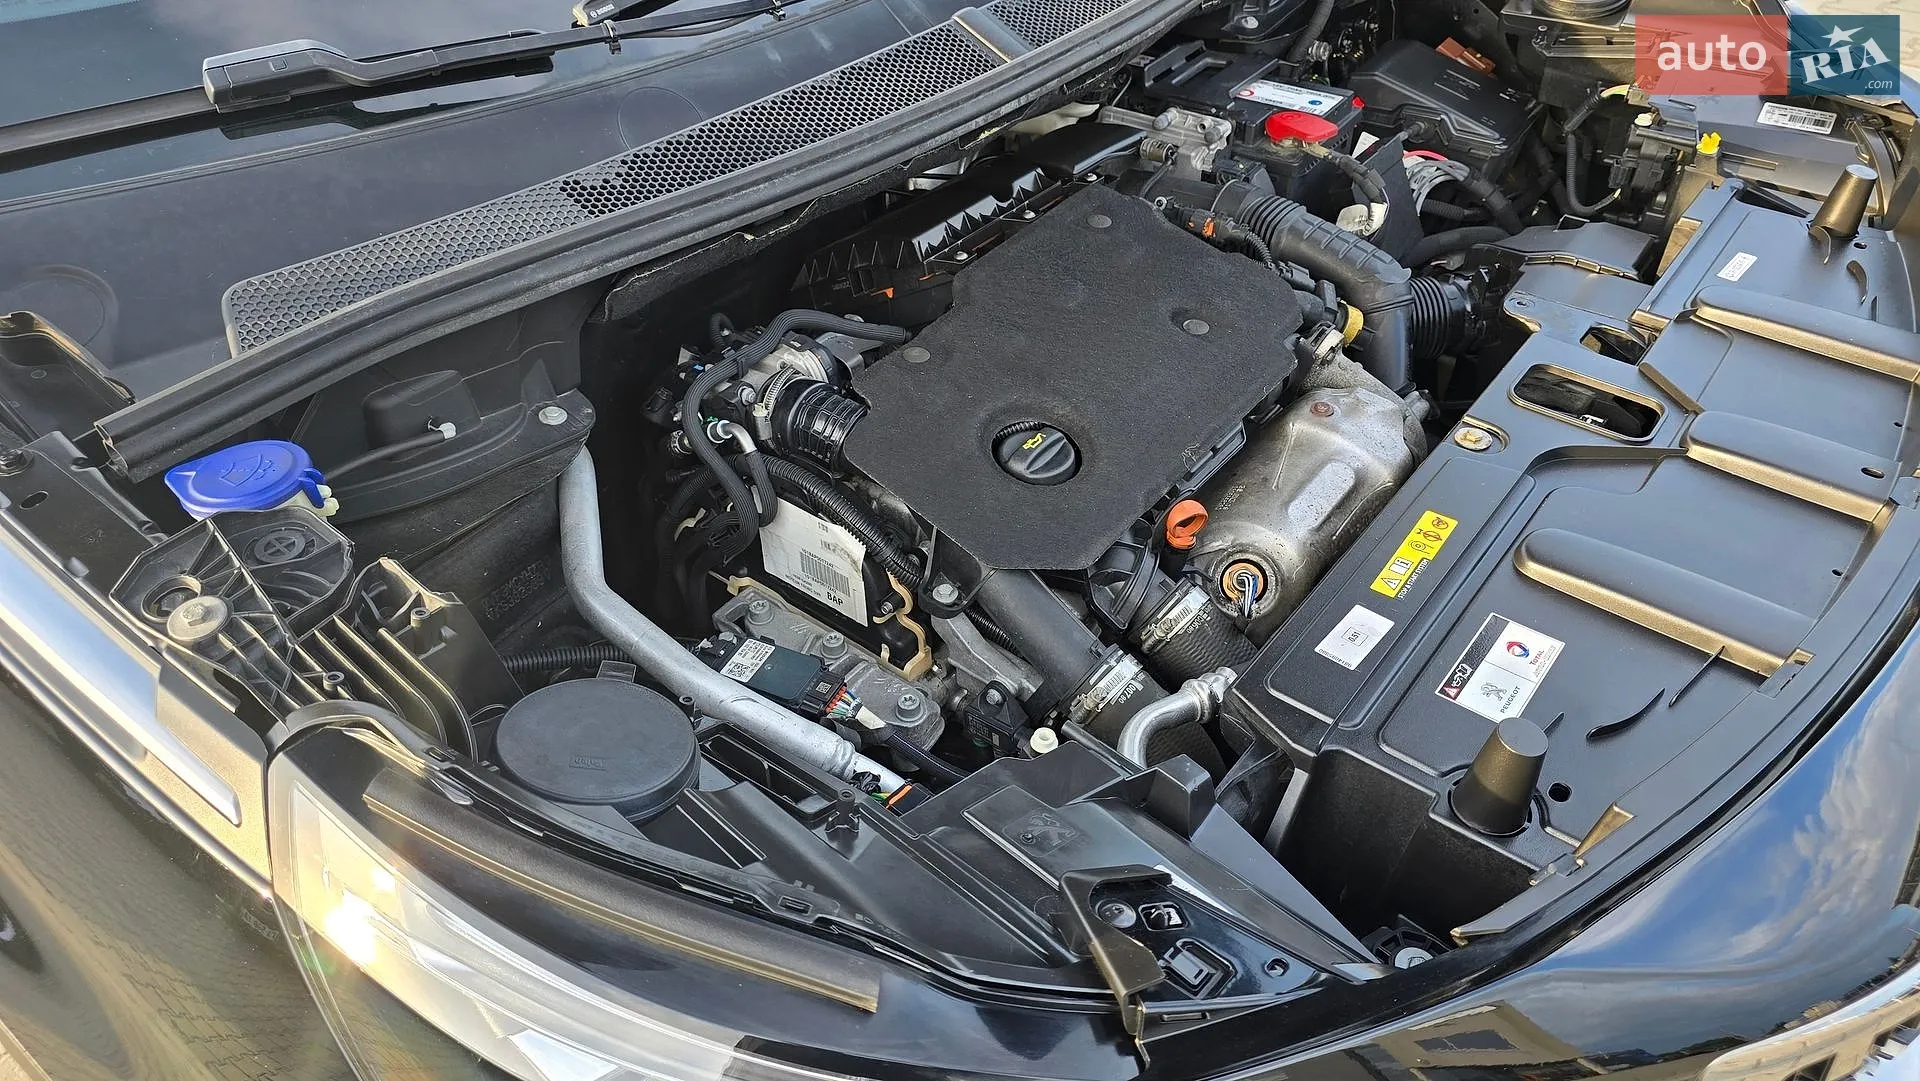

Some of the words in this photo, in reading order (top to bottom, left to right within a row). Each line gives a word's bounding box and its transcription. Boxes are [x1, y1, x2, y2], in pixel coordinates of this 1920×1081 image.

[826, 591, 844, 606] BAP
[1529, 650, 1545, 665] TOTAL
[1500, 685, 1521, 714] PEUGEOT
